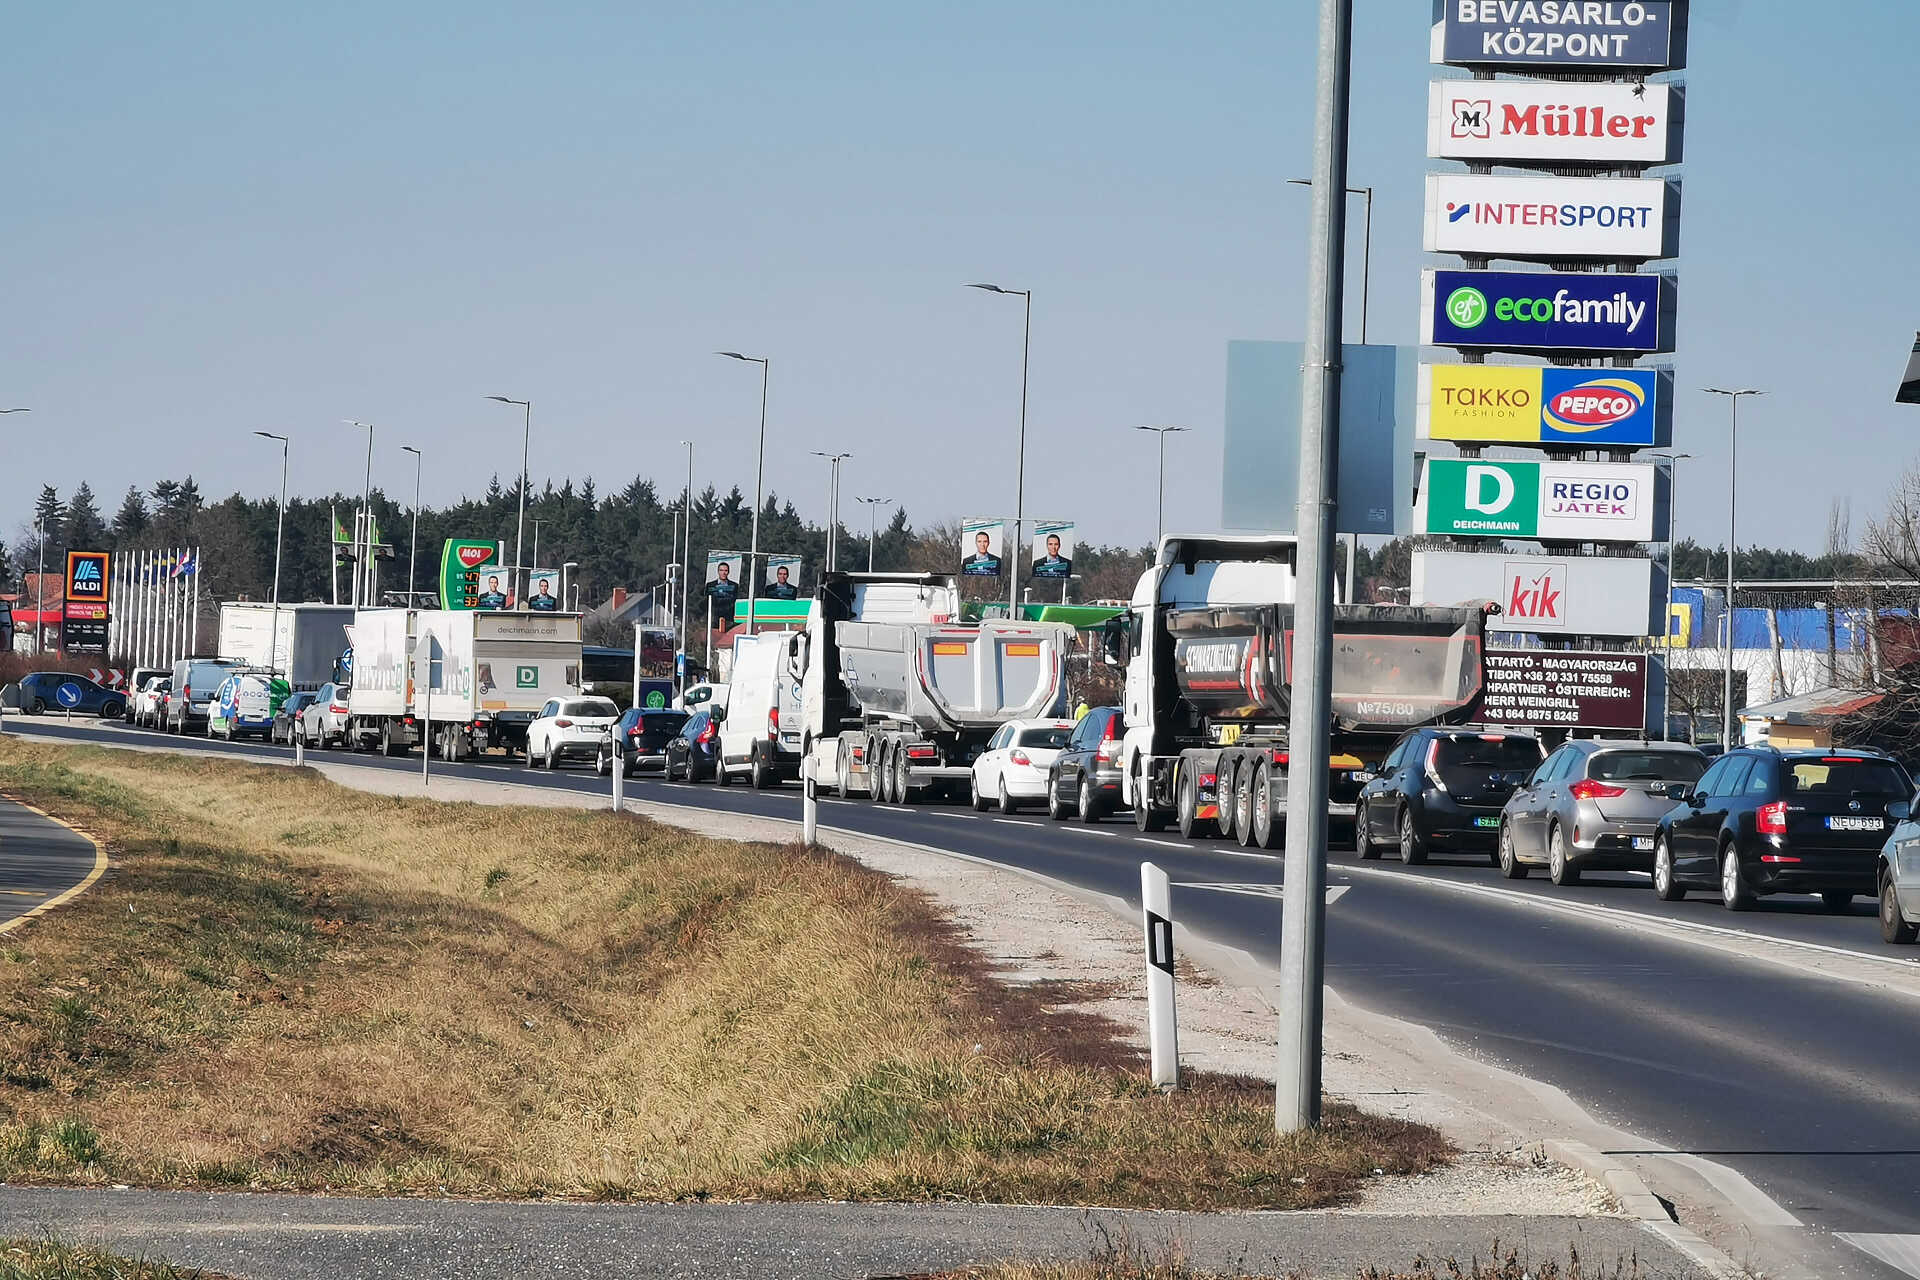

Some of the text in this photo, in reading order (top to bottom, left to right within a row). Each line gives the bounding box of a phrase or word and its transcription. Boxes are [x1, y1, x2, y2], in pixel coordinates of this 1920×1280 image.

[1482, 27, 1628, 57] KÖZPONT
[1461, 111, 1480, 128] M
[1500, 104, 1655, 138] Müller
[1475, 203, 1652, 228] INTERSPORT
[1495, 289, 1645, 333] ecofamily
[1558, 396, 1628, 416] PEPCO
[1454, 410, 1516, 418] FASHION
[1465, 465, 1515, 515] D
[1553, 483, 1629, 500] REGIO
[1552, 500, 1626, 515] JÁTÉK
[1453, 519, 1520, 531] DEICHMANN
[74, 581, 100, 592] ALDI
[1542, 658, 1637, 672] MAGYARORSZÁG
[521, 668, 535, 682] D
[1487, 669, 1521, 680] TIBOR
[1523, 671, 1543, 681] +36
[1545, 671, 1558, 682] 20
[1560, 672, 1578, 683] 331
[1555, 683, 1631, 698] ÖSTERREICH:
[1484, 695, 1579, 709] HERR WEINGRILL
[1484, 708, 1503, 719] +43
